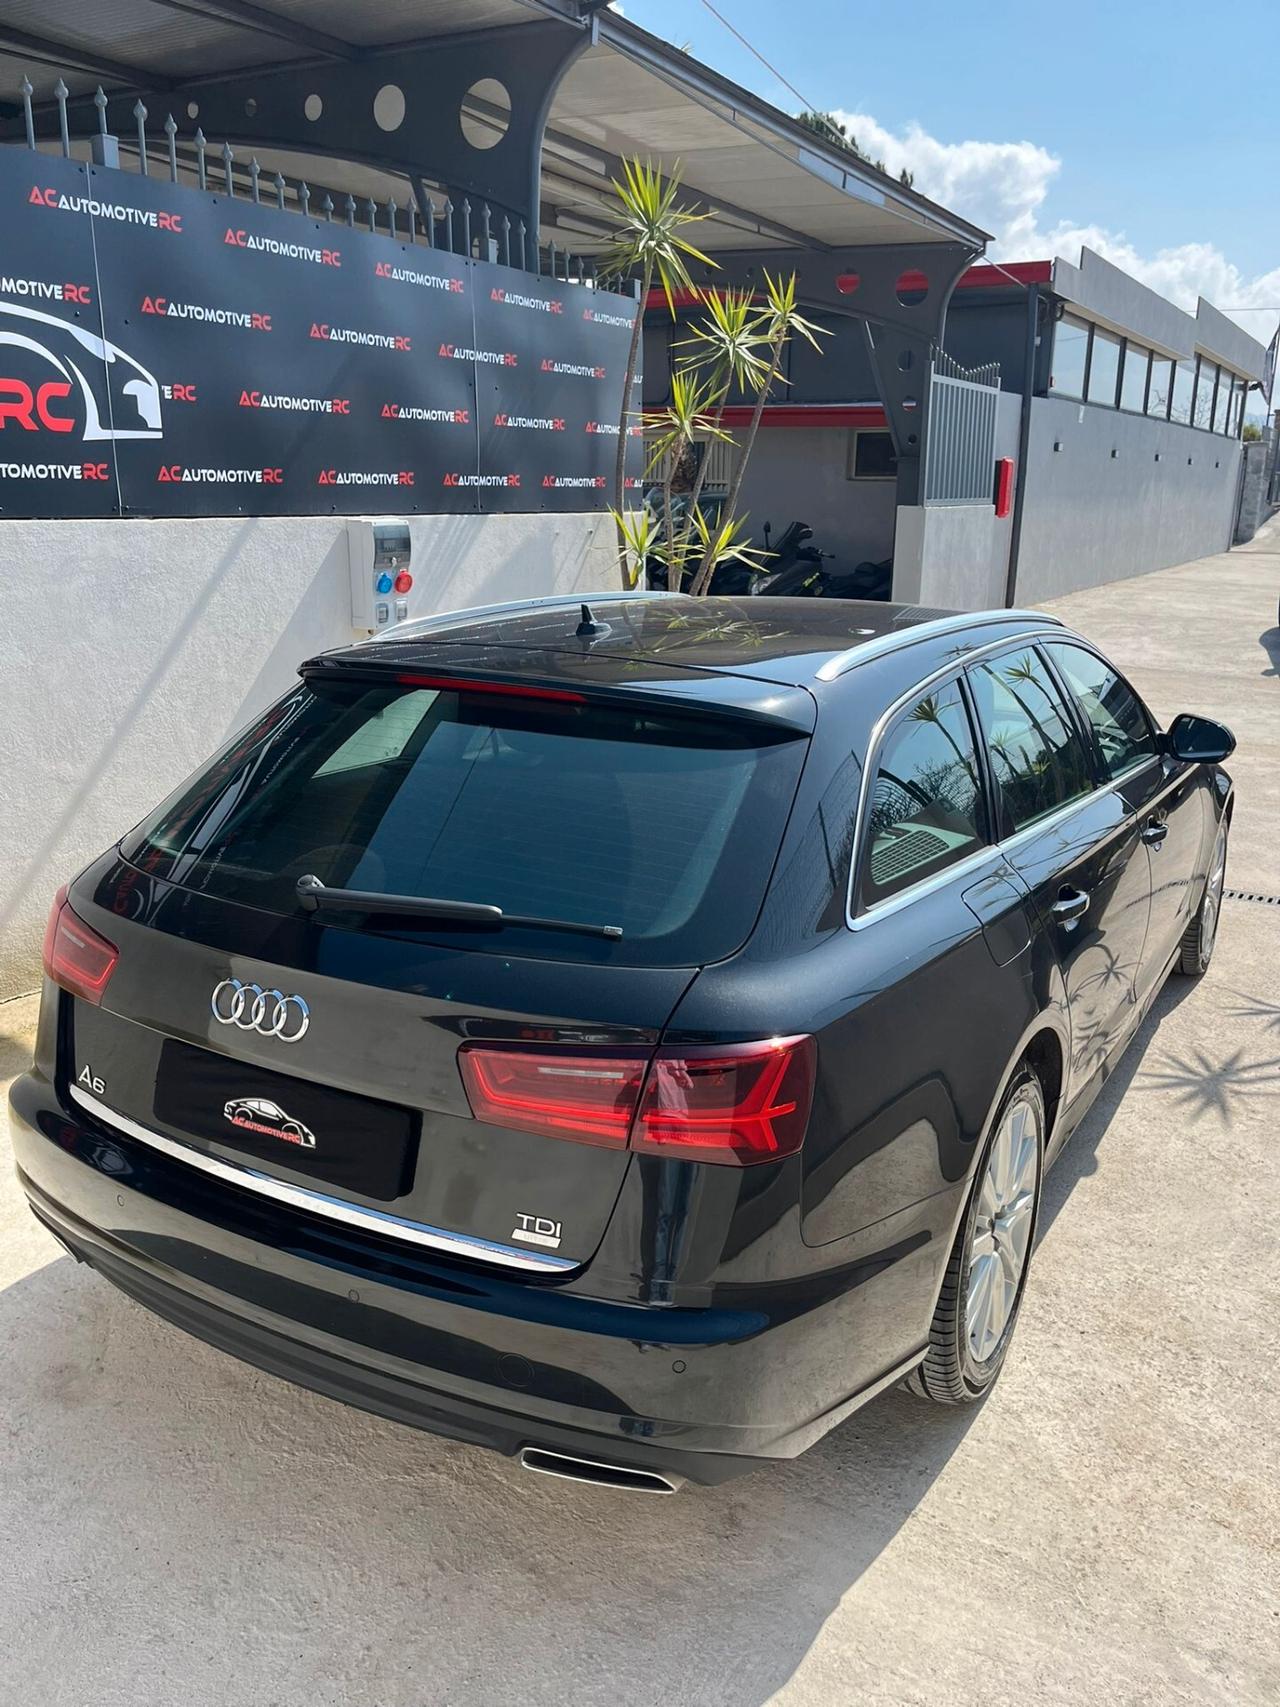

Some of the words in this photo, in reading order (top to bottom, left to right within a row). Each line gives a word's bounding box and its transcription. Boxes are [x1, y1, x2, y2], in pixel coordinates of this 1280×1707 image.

[0, 277, 91, 304] MOTIVERC
[161, 383, 197, 402] ERC
[79, 1065, 106, 1095] A6
[516, 1213, 562, 1238] TDI
